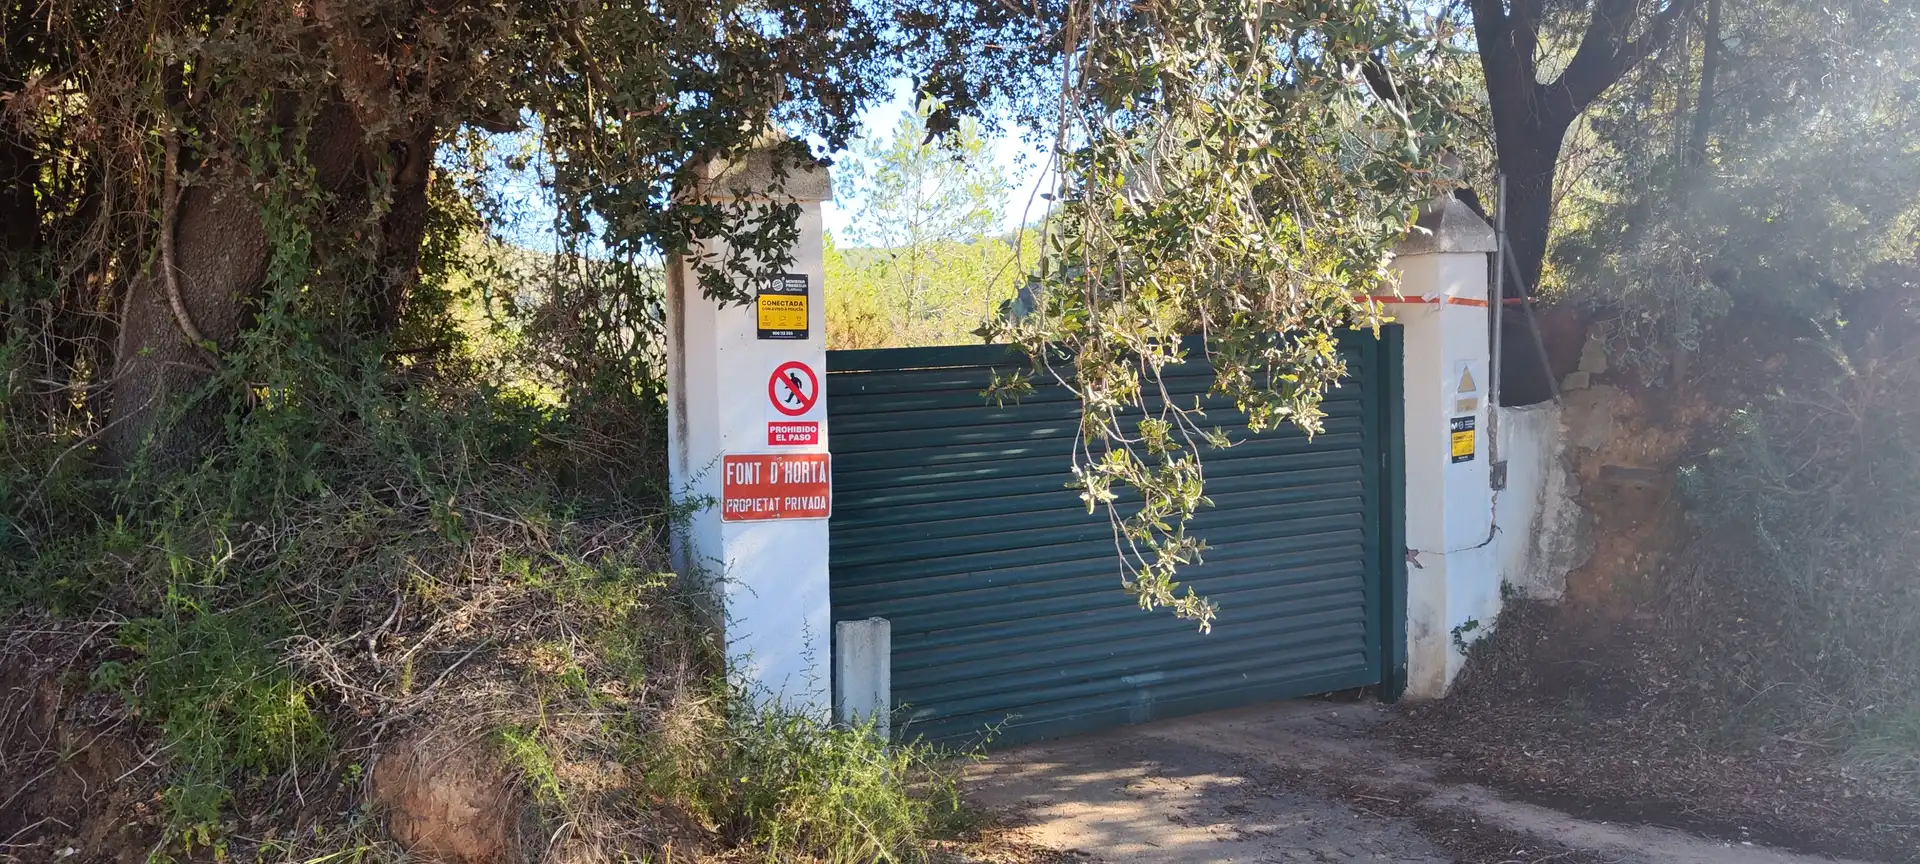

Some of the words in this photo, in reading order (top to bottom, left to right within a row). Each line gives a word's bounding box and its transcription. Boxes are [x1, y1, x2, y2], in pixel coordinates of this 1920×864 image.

[770, 426, 817, 434] PROHIBIDO
[726, 462, 762, 486] FONT
[726, 498, 780, 513] PROPIETAT
[784, 496, 826, 510] PRIVADA
